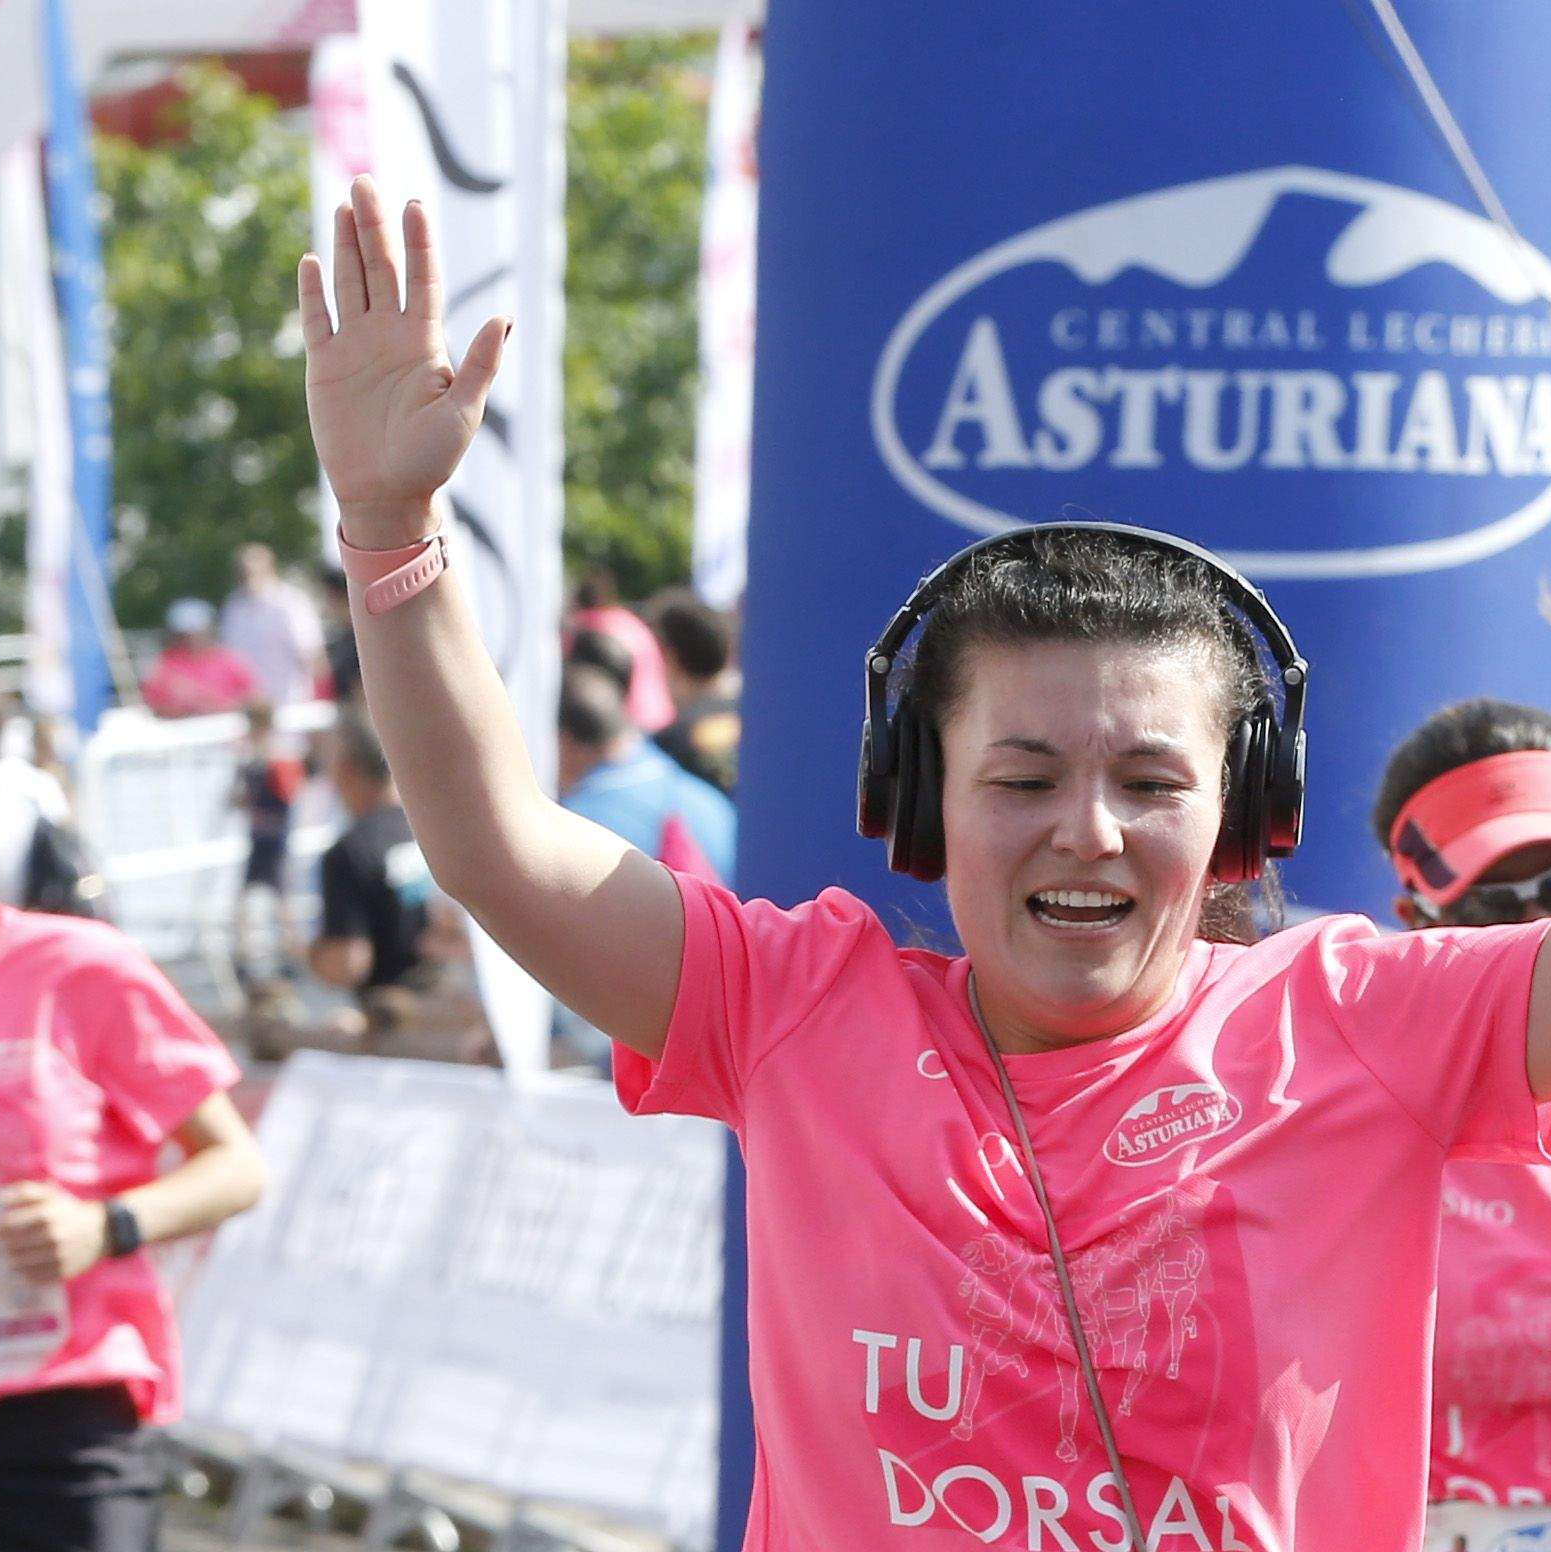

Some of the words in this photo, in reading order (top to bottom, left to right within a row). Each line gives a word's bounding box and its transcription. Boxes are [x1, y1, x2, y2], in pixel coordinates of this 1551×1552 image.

[1050, 308, 1321, 350] CENTRAL
[1179, 1095, 1221, 1115] LECHER
[1117, 1102, 1234, 1160] ASTURIANA
[853, 1329, 964, 1421] TU
